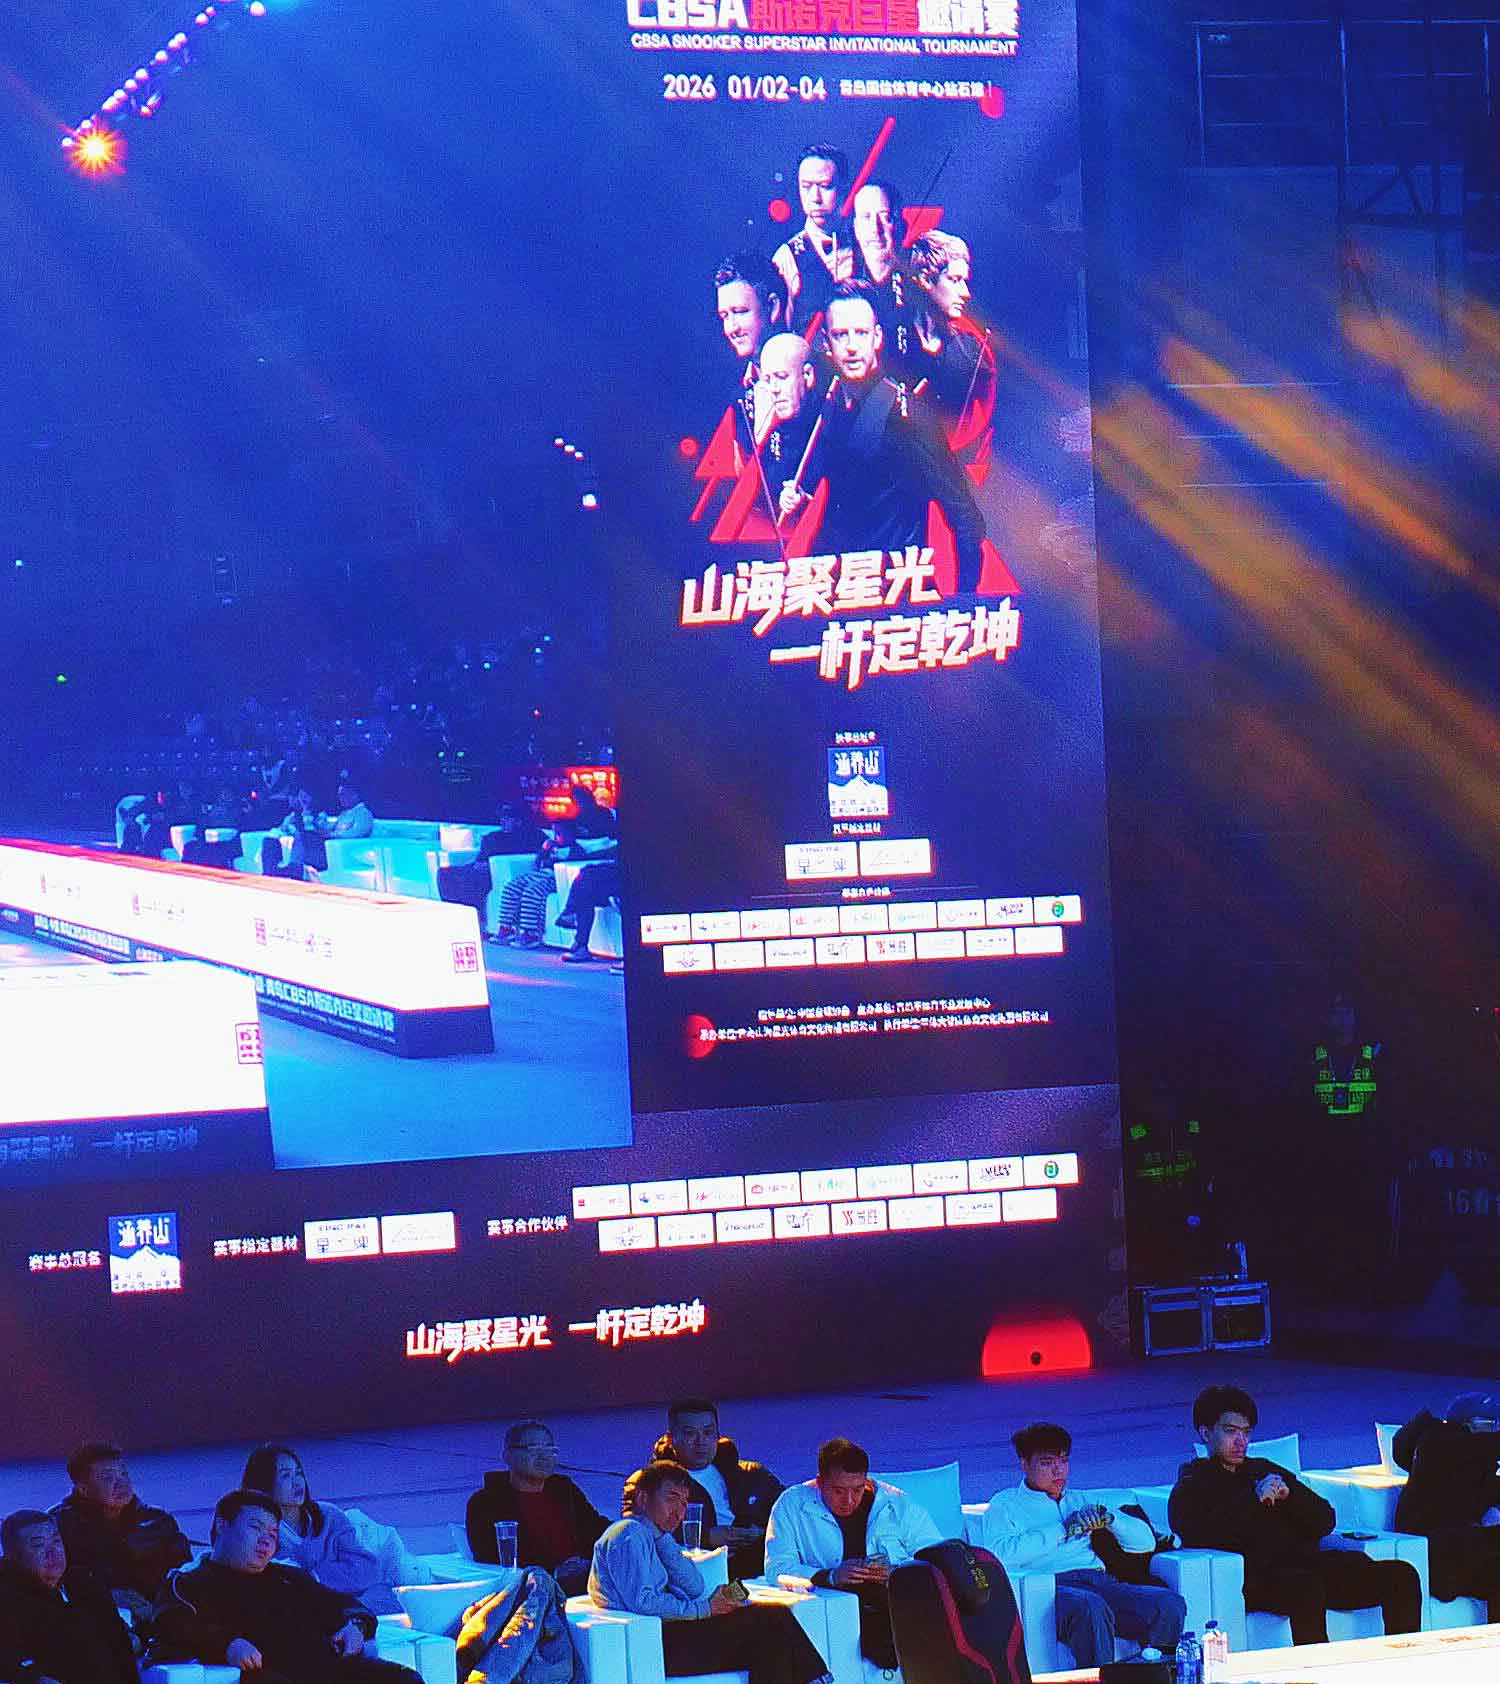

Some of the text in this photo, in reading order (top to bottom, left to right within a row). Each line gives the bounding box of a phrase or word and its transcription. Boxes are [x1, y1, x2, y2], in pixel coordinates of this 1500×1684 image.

[631, 33, 1018, 55] CBSA SNOOKER SUPERSTAR INVITATIONAL TOURNAMENT
[663, 74, 715, 100] 2026
[728, 75, 826, 100] 01/02-04
[681, 545, 941, 637] 山海聚星光
[770, 598, 1020, 689] 一杆定乾坤
[406, 1298, 707, 1363] 山海聚星光 一杆定乾坤
